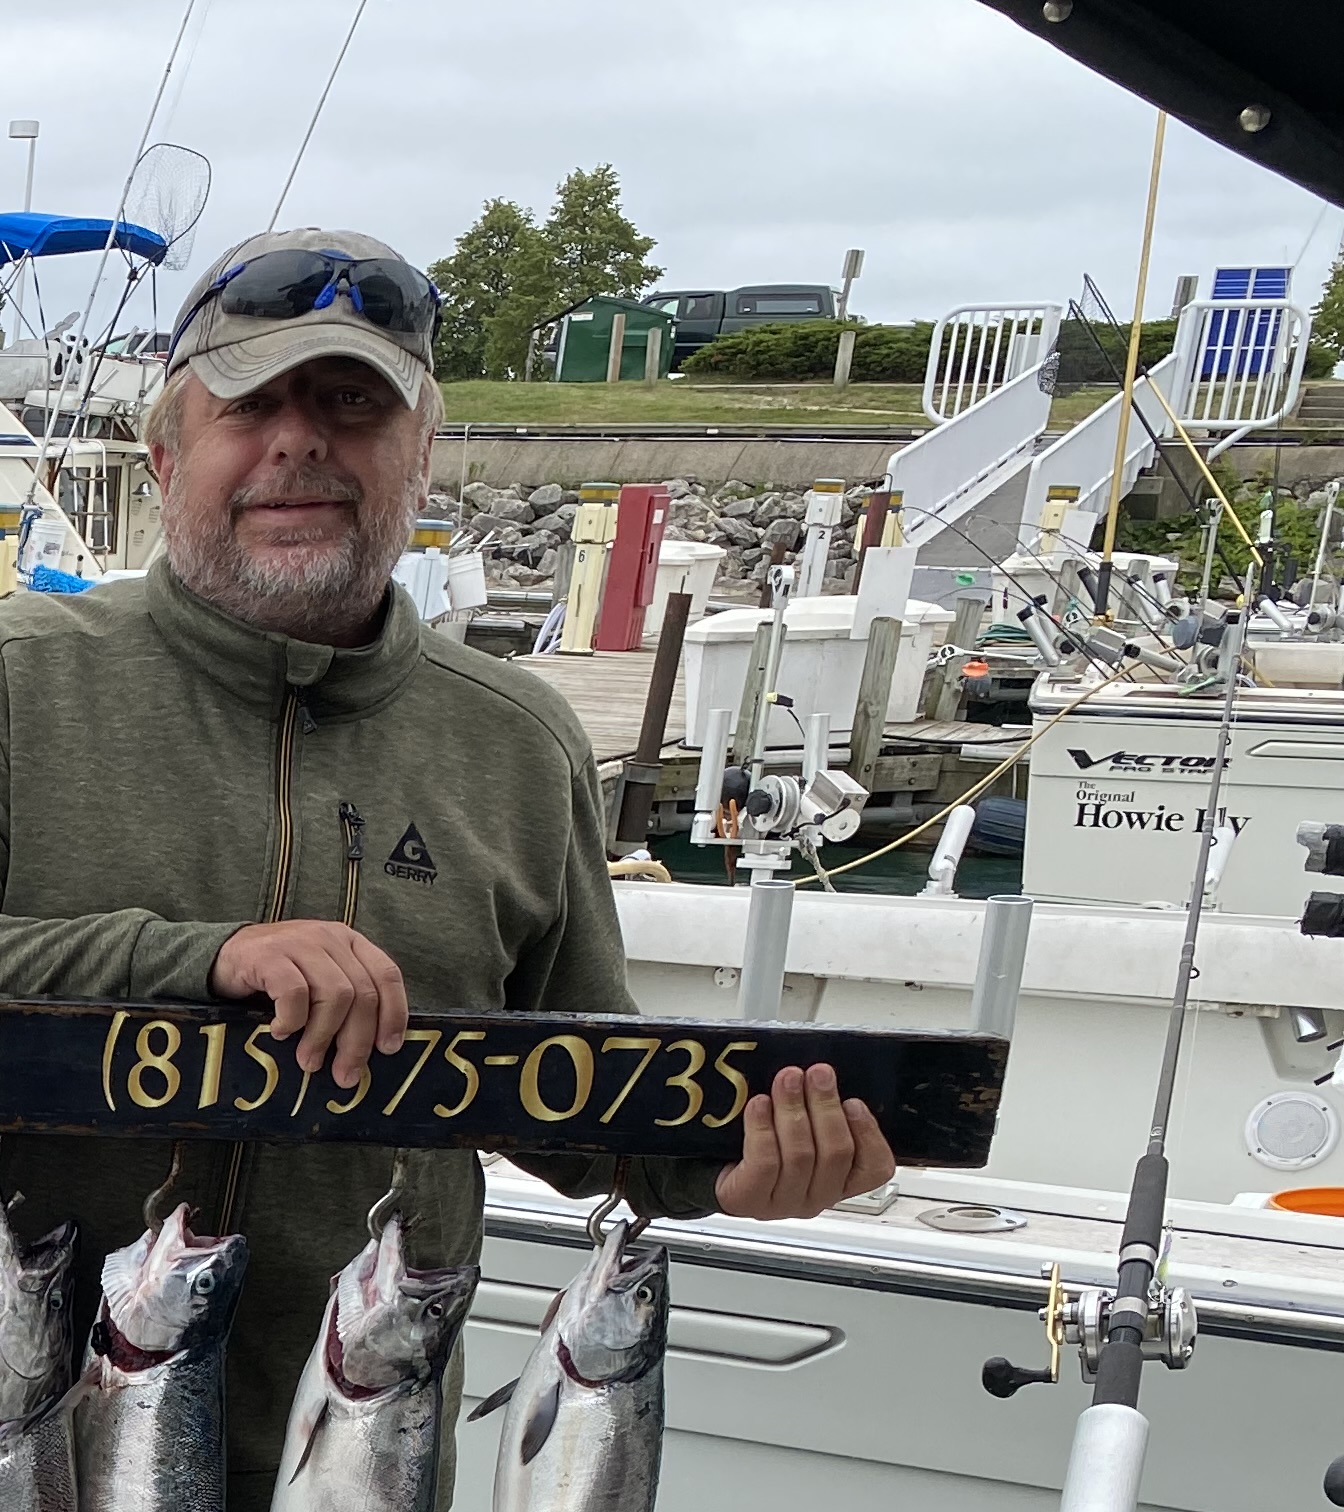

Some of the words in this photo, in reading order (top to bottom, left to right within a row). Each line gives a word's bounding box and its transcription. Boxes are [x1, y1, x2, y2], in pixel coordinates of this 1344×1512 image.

[818, 530, 826, 540] 2
[578, 549, 586, 563] 6
[1066, 748, 1233, 770] VECTOR
[1078, 781, 1096, 790] The
[1076, 789, 1136, 806] Original
[1074, 802, 1185, 833] Howie
[384, 862, 438, 885] GERRY
